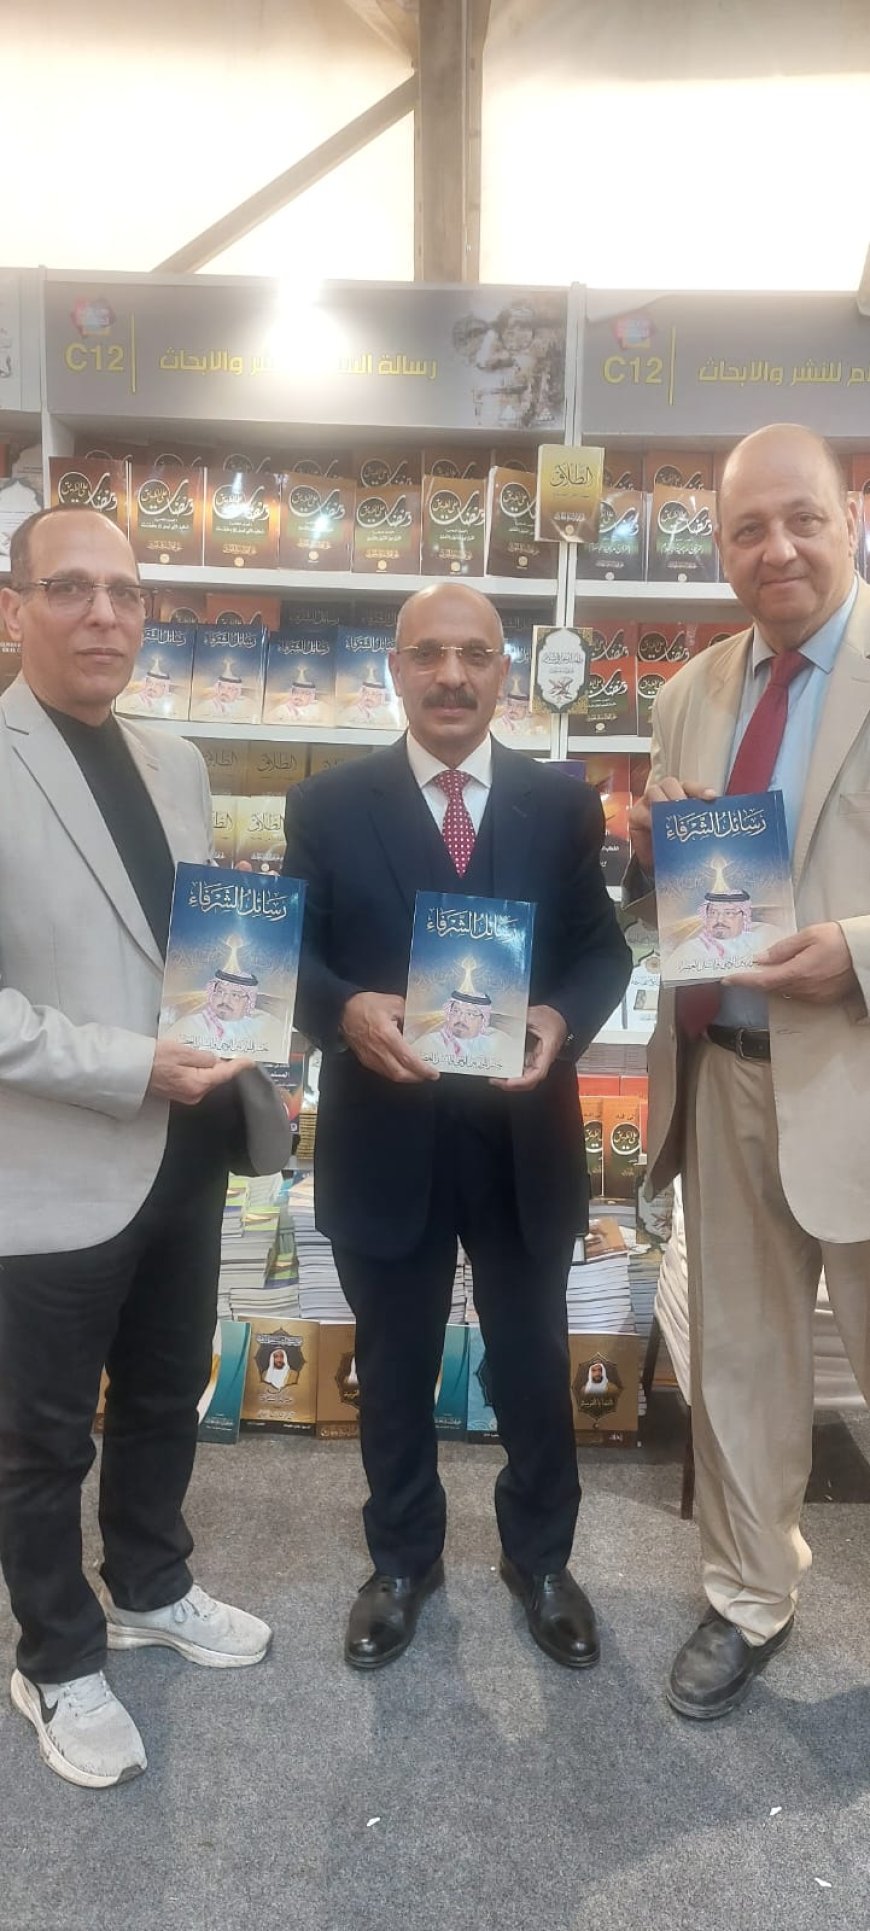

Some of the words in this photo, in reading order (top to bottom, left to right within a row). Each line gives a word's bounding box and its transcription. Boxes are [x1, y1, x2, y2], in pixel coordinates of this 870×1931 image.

[64, 342, 125, 372] C12
[159, 345, 243, 376] والابحاث
[378, 352, 439, 381] رسالة
[603, 355, 663, 384] C12
[699, 357, 784, 387] والابحاث
[790, 358, 843, 387] للنشر
[549, 462, 595, 487] الطلاق
[256, 751, 298, 773] الطلاق
[665, 811, 722, 843] الشرفاء
[717, 808, 768, 839] رسائل
[188, 880, 246, 914] الشرفاء
[240, 885, 289, 922] رسائل
[426, 907, 478, 938] الشرفاء
